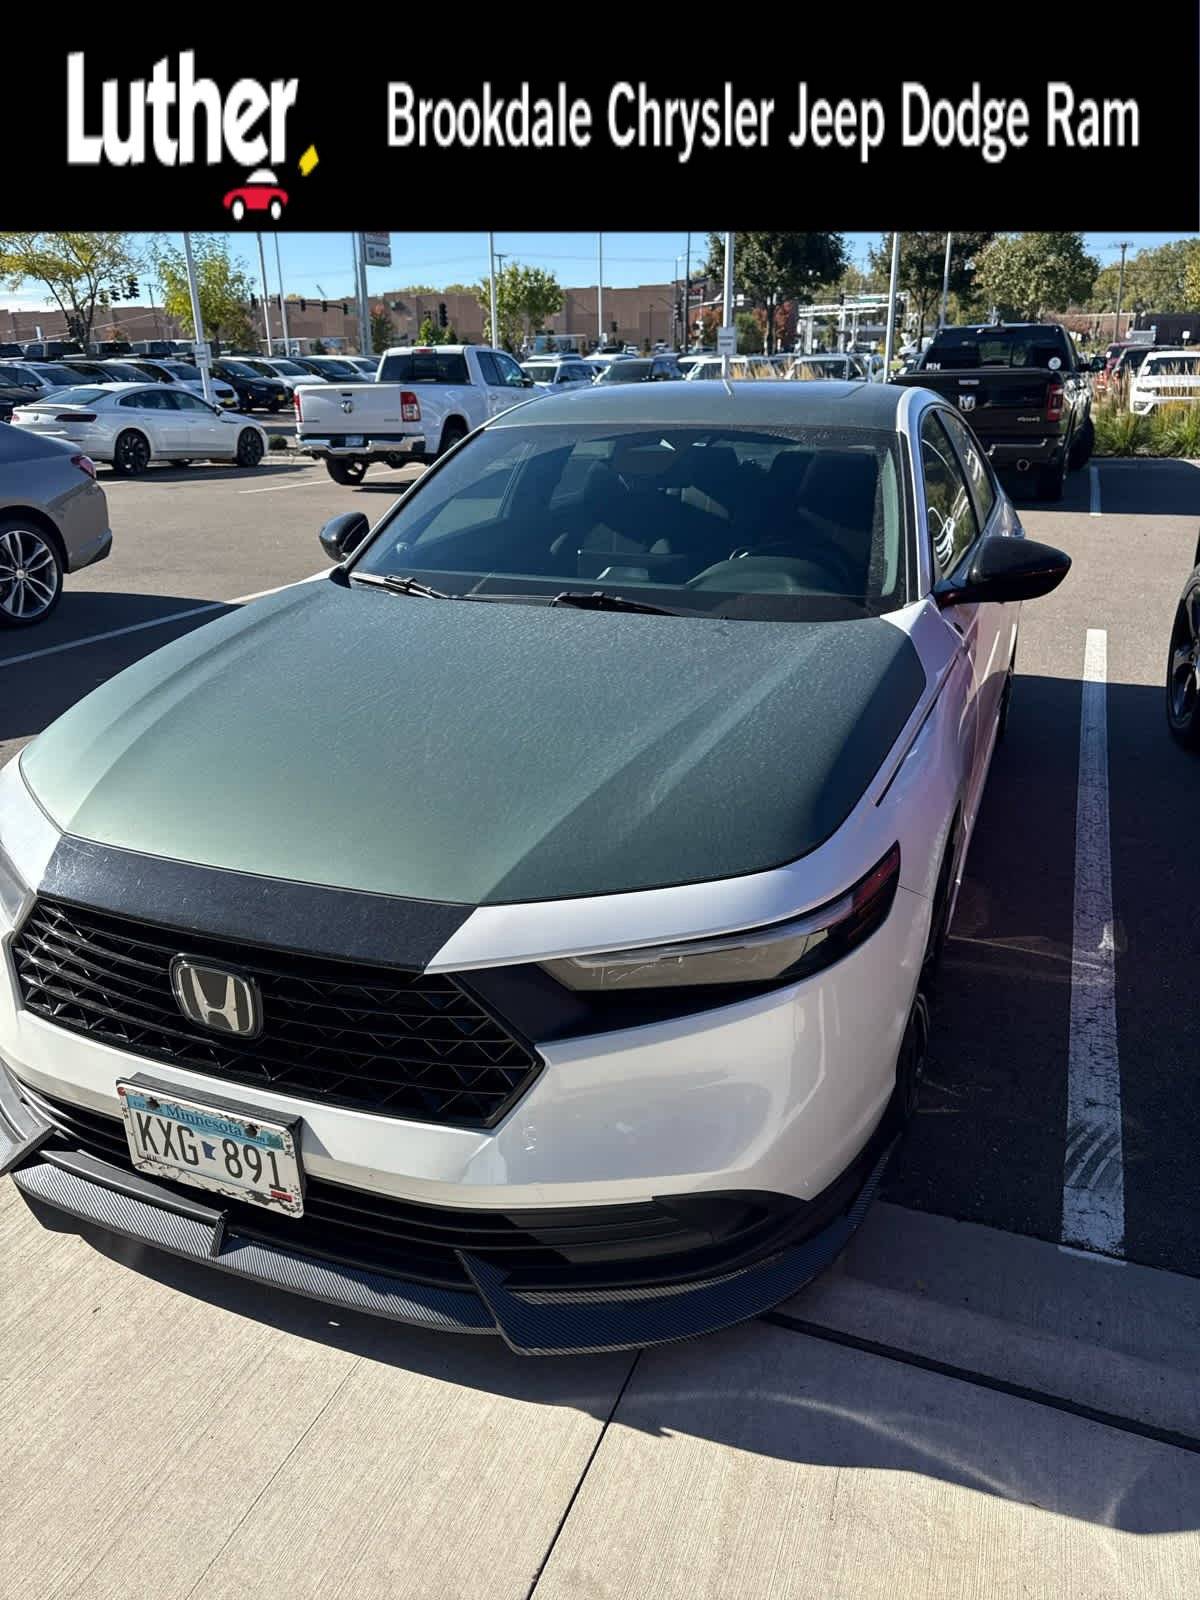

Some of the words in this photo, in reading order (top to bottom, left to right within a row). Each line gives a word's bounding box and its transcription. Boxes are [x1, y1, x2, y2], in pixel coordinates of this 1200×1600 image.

[166, 1104, 243, 1138] Minnesota
[136, 1112, 200, 1166] KXG
[222, 1138, 287, 1193] 891
